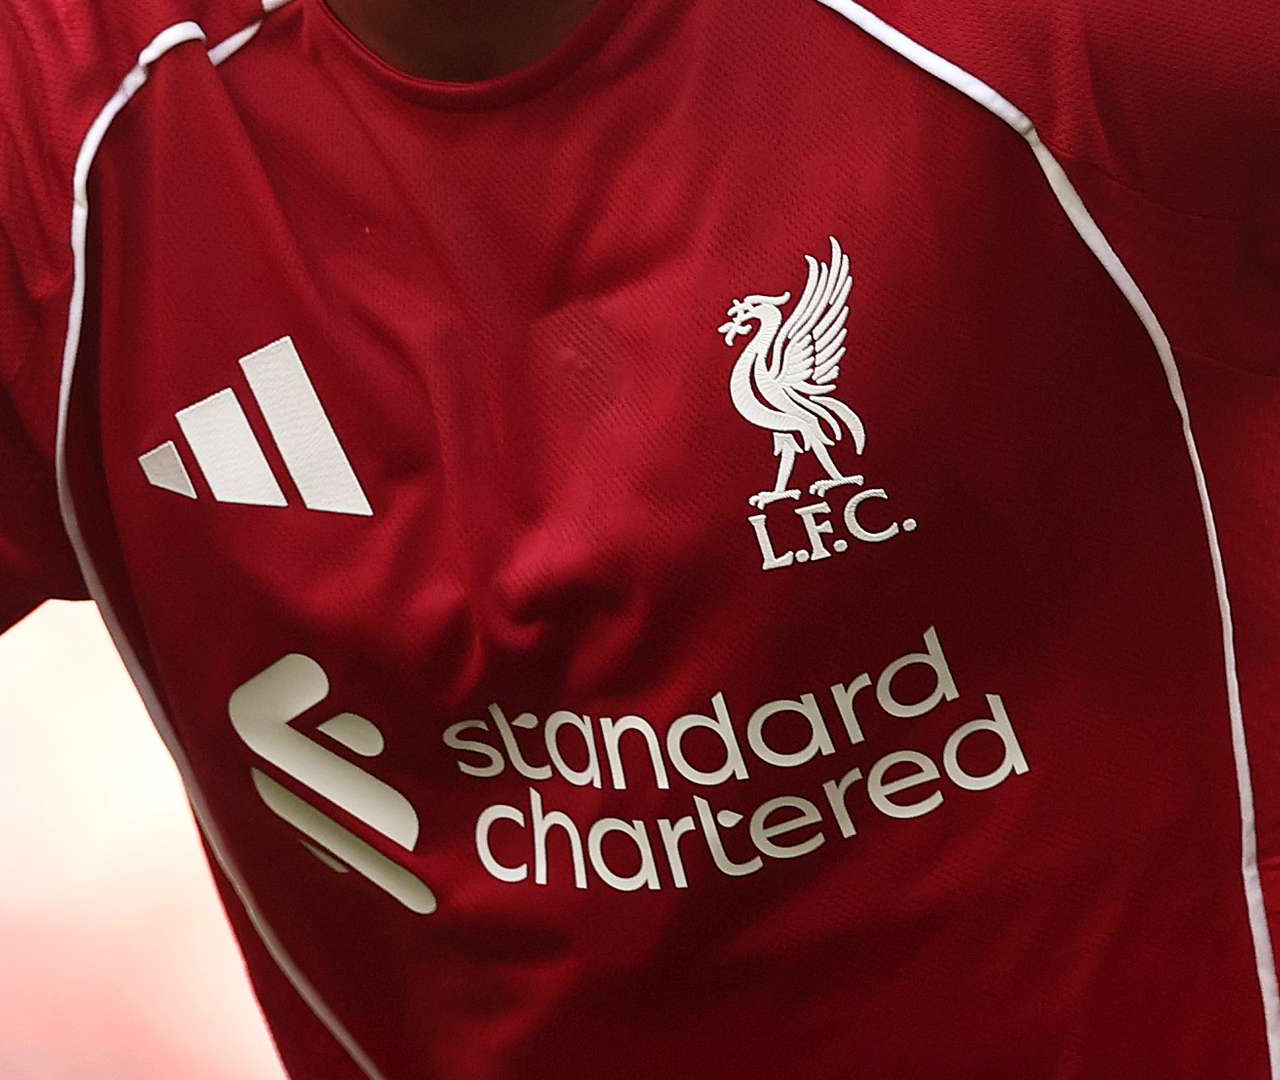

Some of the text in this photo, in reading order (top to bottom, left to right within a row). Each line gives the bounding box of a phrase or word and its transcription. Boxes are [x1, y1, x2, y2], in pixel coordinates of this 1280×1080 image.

[747, 488, 918, 571] L.F.C.
[442, 624, 961, 791] standard
[474, 693, 1030, 891] chartered
